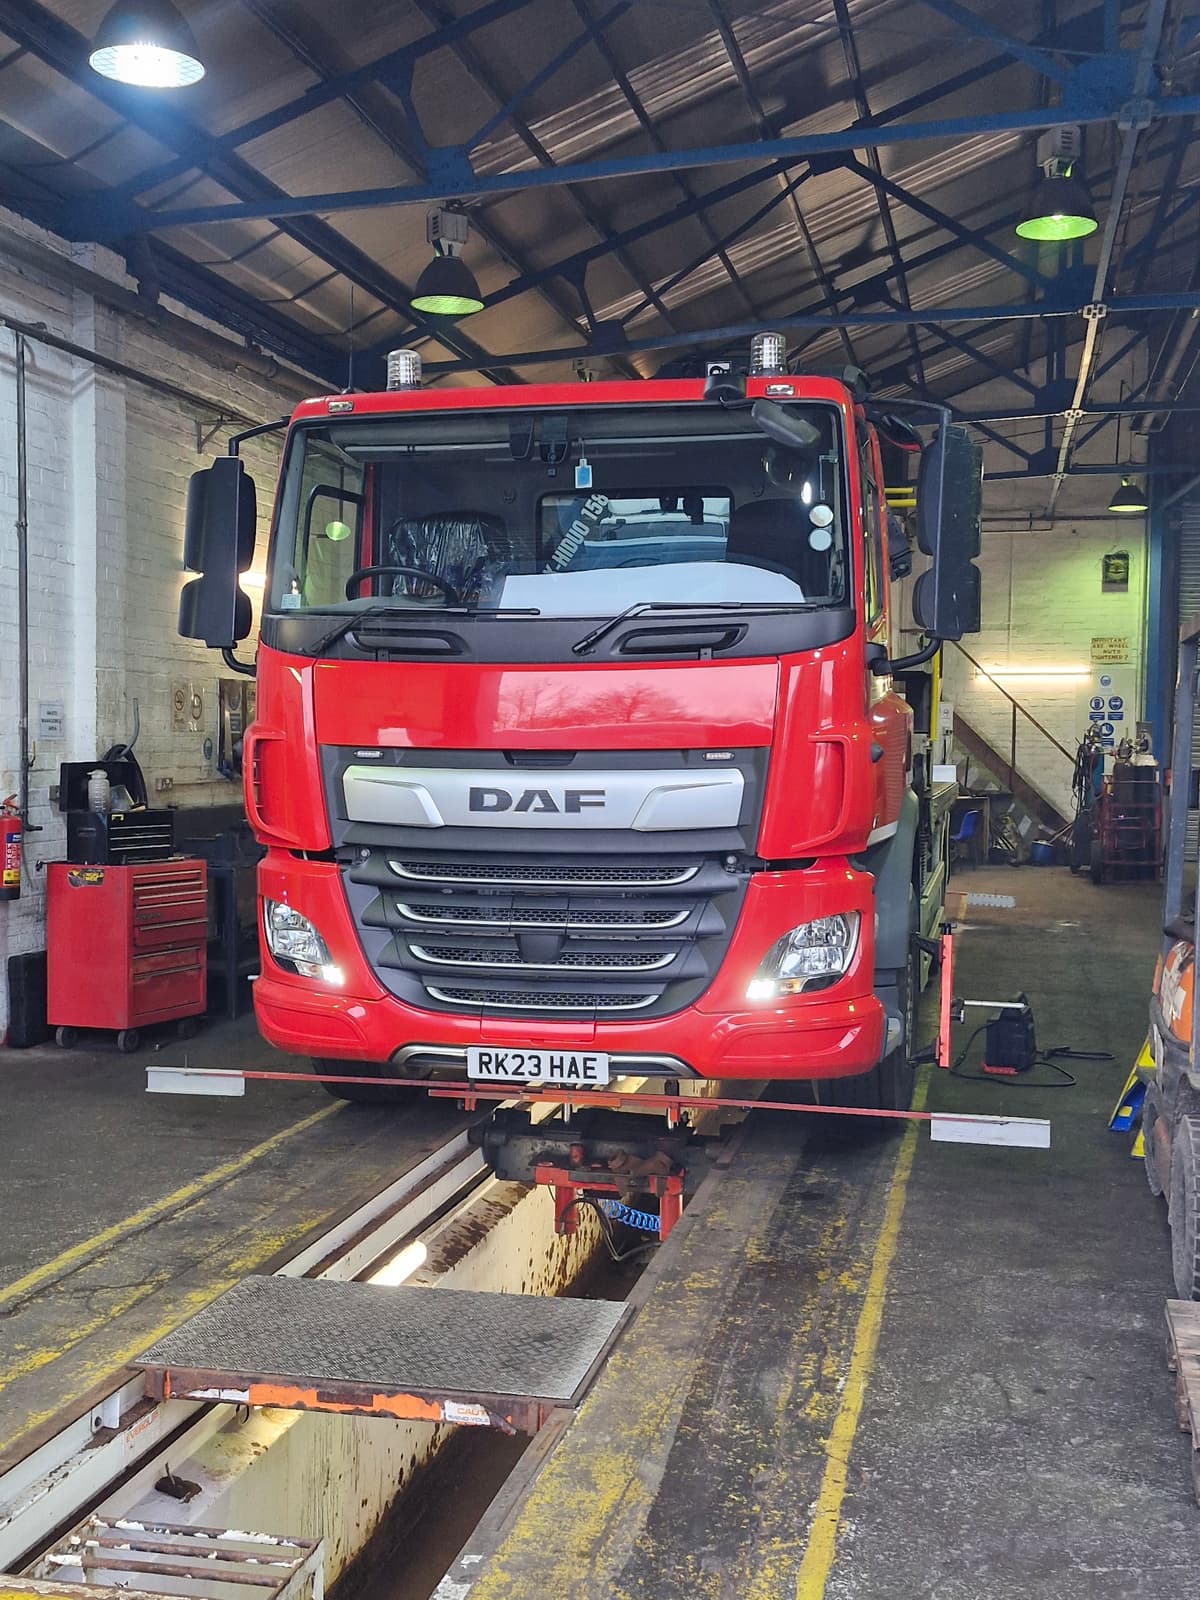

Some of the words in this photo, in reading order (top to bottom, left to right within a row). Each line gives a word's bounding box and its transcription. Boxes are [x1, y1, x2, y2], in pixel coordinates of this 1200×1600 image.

[581, 493, 608, 521] 158
[469, 787, 606, 813] DAF
[478, 1051, 542, 1077] RK23
[549, 1055, 598, 1080] HAE
